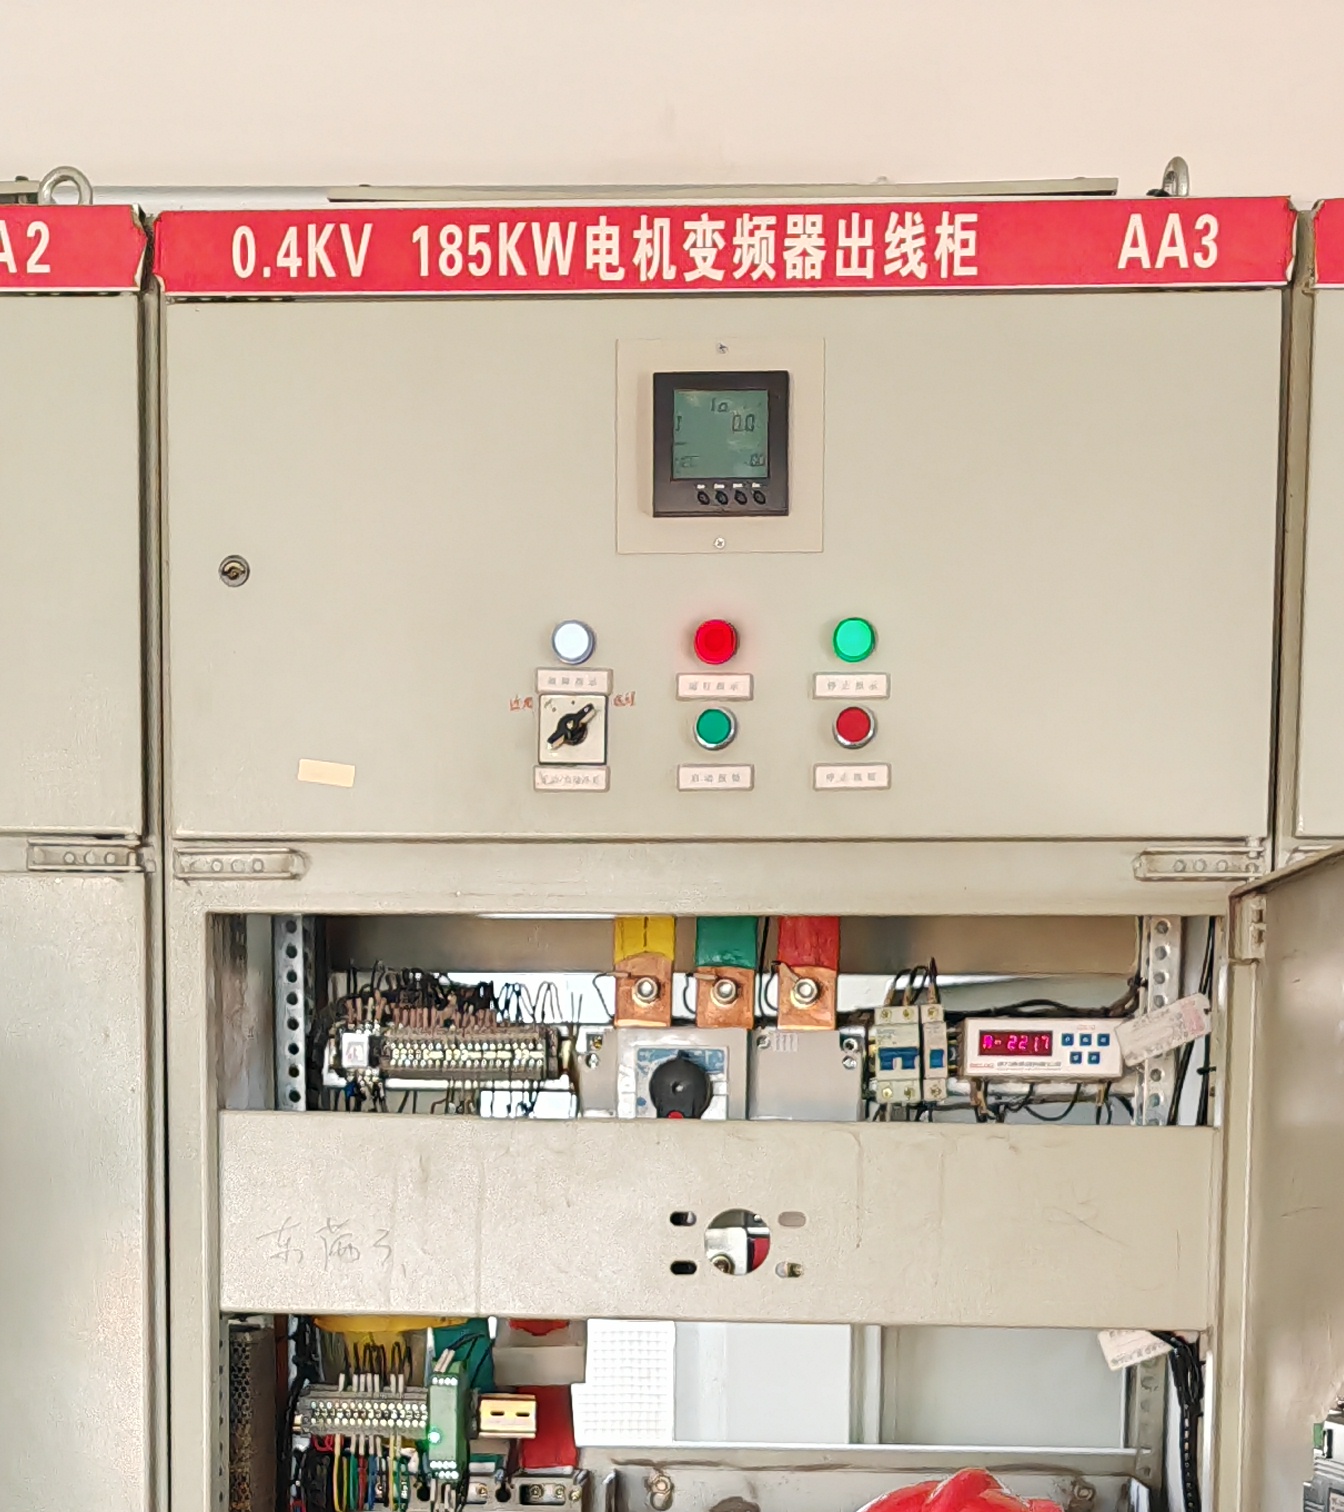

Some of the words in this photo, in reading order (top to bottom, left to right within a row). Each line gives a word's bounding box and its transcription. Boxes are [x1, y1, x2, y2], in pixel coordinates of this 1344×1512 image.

[231, 222, 373, 279] 0.4KV
[411, 212, 978, 282] 185KW电机变频器出线柜
[1117, 213, 1219, 270] AA3
